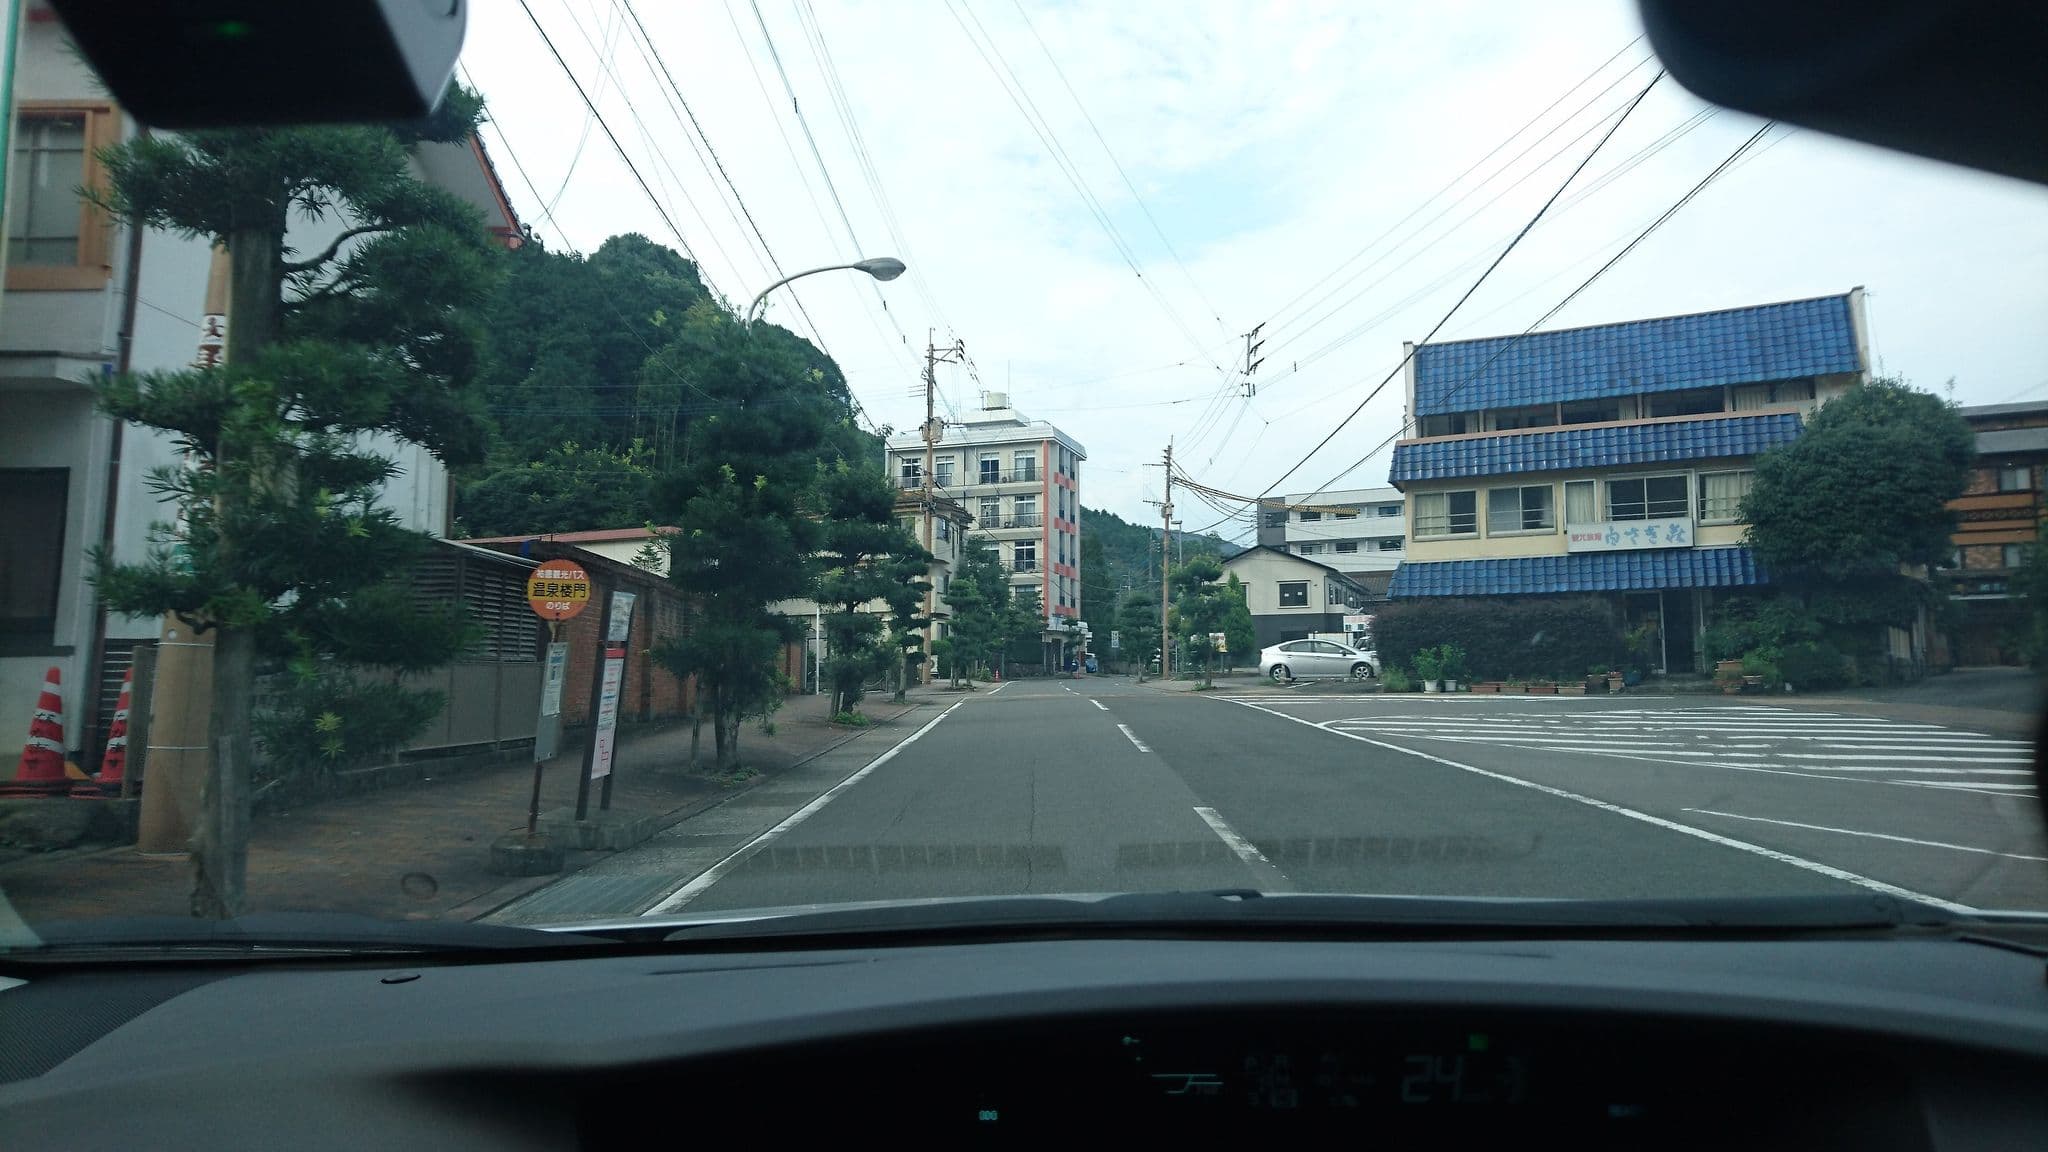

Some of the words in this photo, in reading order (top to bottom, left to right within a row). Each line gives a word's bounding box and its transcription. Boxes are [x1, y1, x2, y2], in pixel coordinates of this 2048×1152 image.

[532, 582, 586, 598] 温泉楼門
[546, 601, 571, 610] のりば
